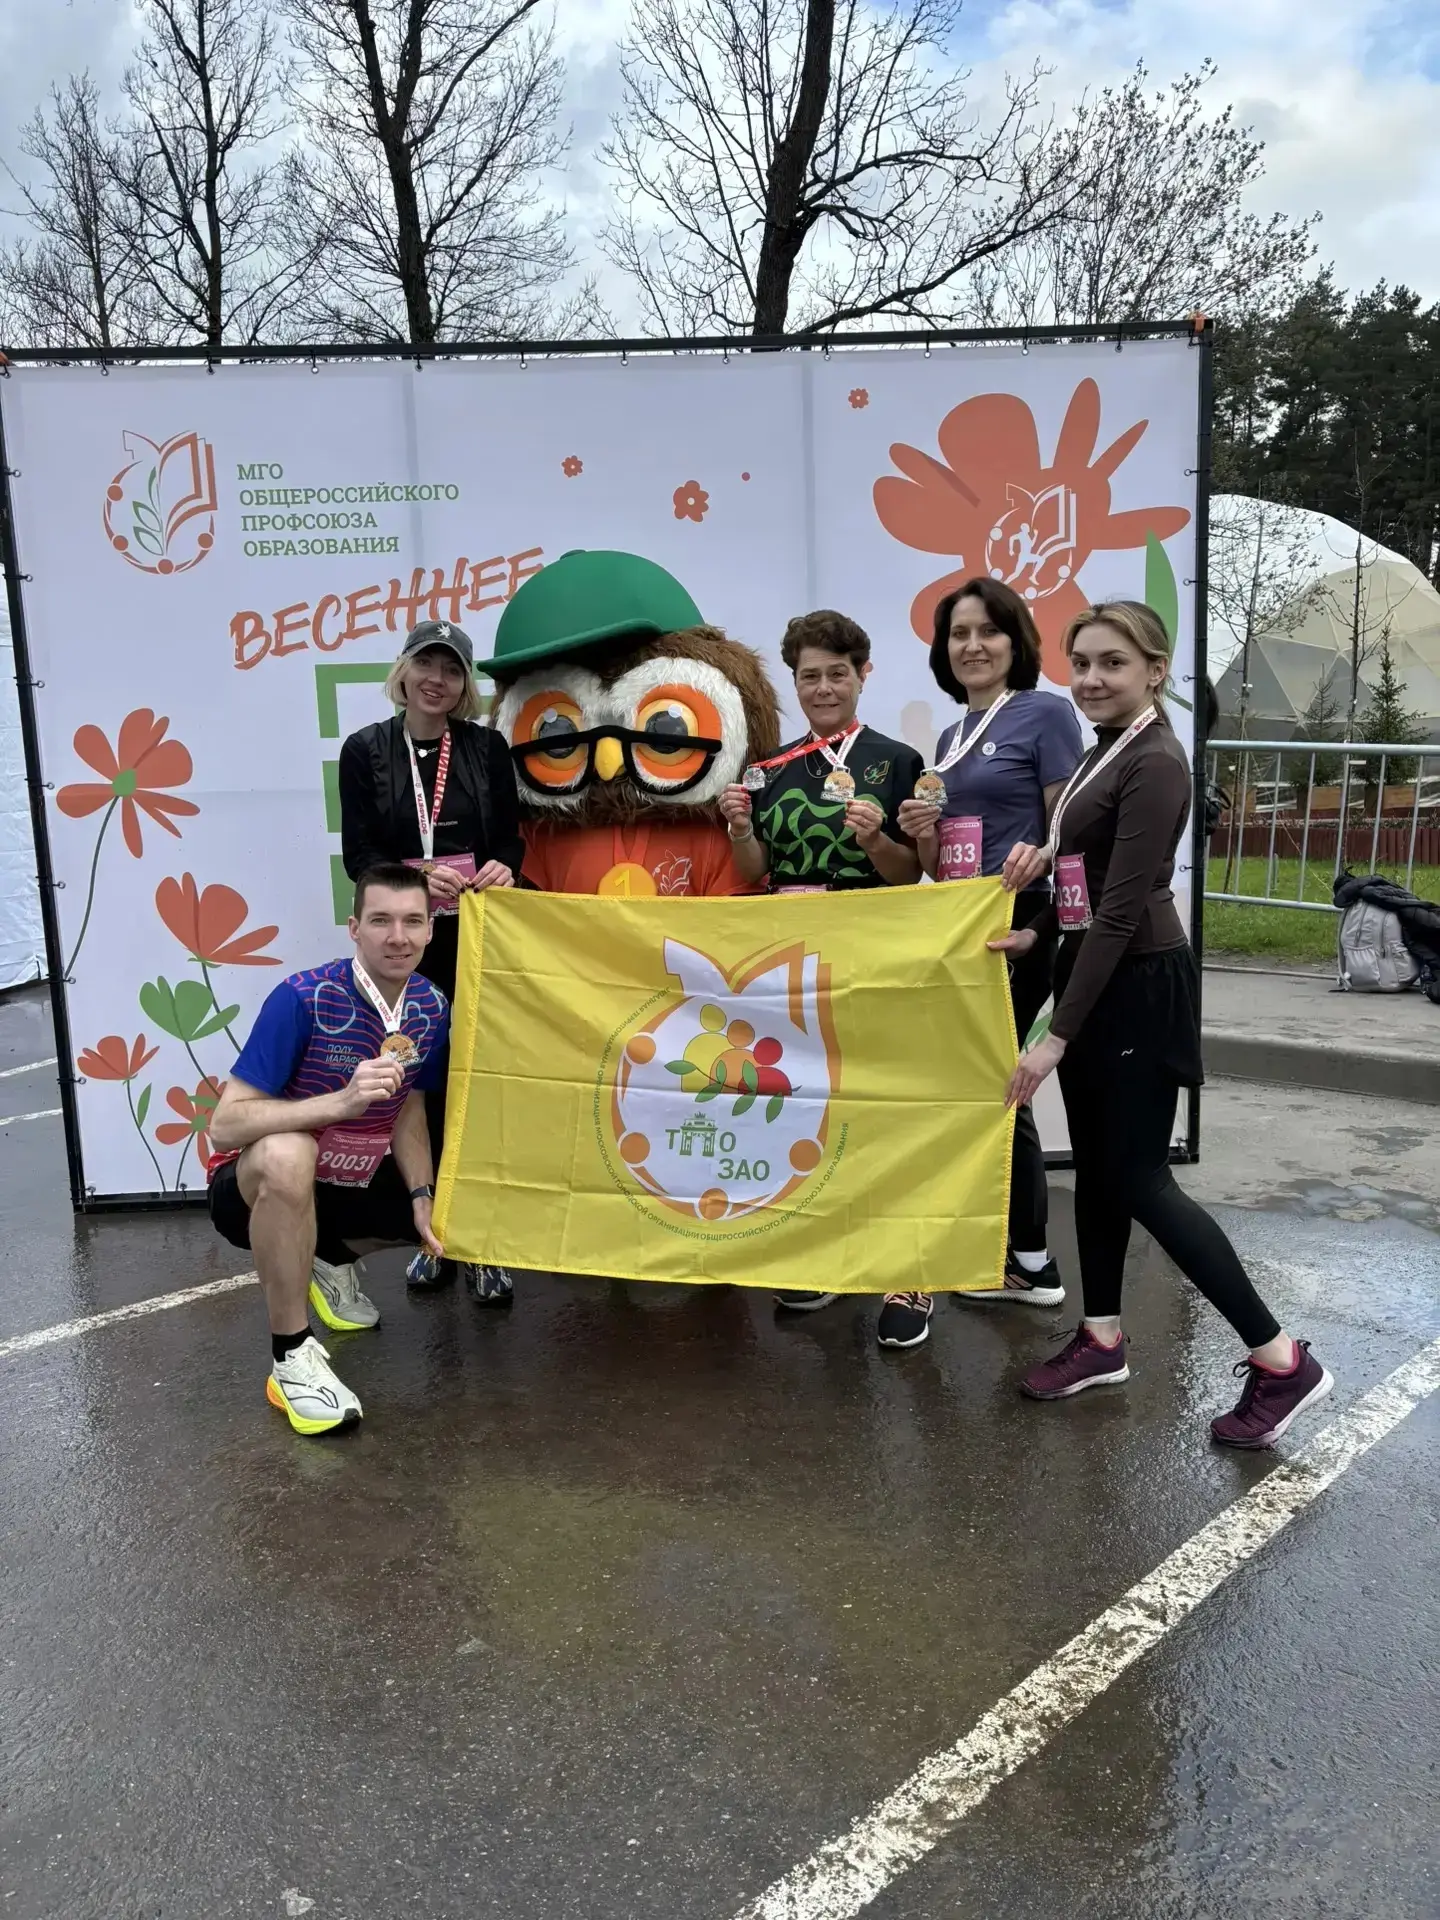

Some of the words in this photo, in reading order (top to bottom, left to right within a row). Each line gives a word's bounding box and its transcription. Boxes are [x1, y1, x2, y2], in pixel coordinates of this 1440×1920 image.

[237, 463, 283, 480] МГО
[239, 482, 459, 507] ОБЩЕРОССИЙСКОГО
[241, 512, 378, 532] ПРОФСОЮЗА
[243, 536, 400, 557] ОБРАЗОВАНИЯ
[327, 1044, 354, 1053] ПОЛУ
[325, 1054, 362, 1064] МАРАФО
[318, 1151, 377, 1171] 90031
[717, 1158, 770, 1181] ЗАО
[595, 1127, 618, 1181] МОСКОВСКОЙ
[647, 1212, 700, 1239] ОРГАНИЗАЦИИ
[700, 1219, 780, 1242] ОБЩЕРОССИЙСКОГО
[780, 1182, 826, 1223] ПРОФСОЮЗА
[823, 1122, 849, 1181] ОБРАЗОВАНИЯ
